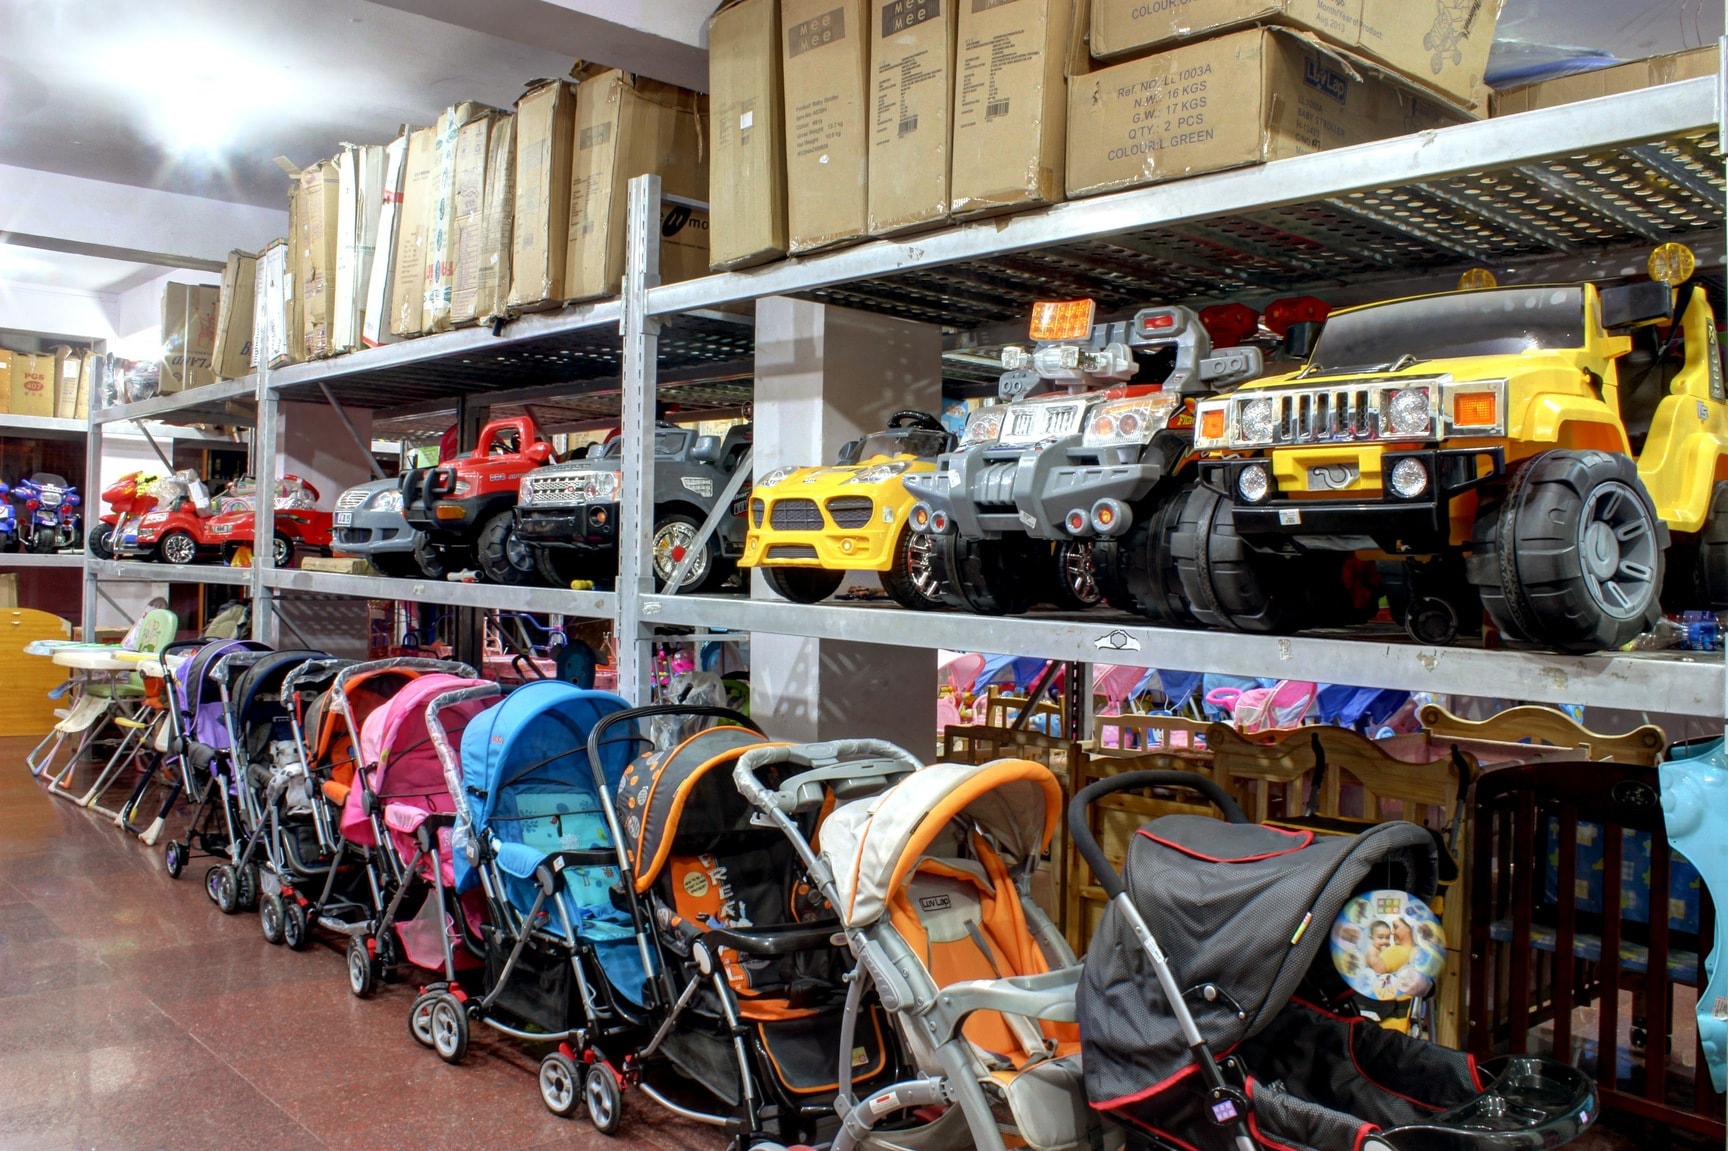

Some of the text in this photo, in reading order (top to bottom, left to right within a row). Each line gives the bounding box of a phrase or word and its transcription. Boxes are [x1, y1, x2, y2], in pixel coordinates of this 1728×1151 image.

[800, 15, 832, 36] Mee
[894, 8, 926, 31] Mee
[1316, 13, 1346, 33] Aug 2013
[800, 30, 832, 51] Mee
[1117, 85, 1137, 99] Ref.
[1168, 88, 1179, 99] 16
[1182, 81, 1207, 96] KGS
[1132, 97, 1207, 124] G.W.: 17 KGS
[1164, 120, 1171, 132] 2
[1178, 114, 1204, 129] PCS
